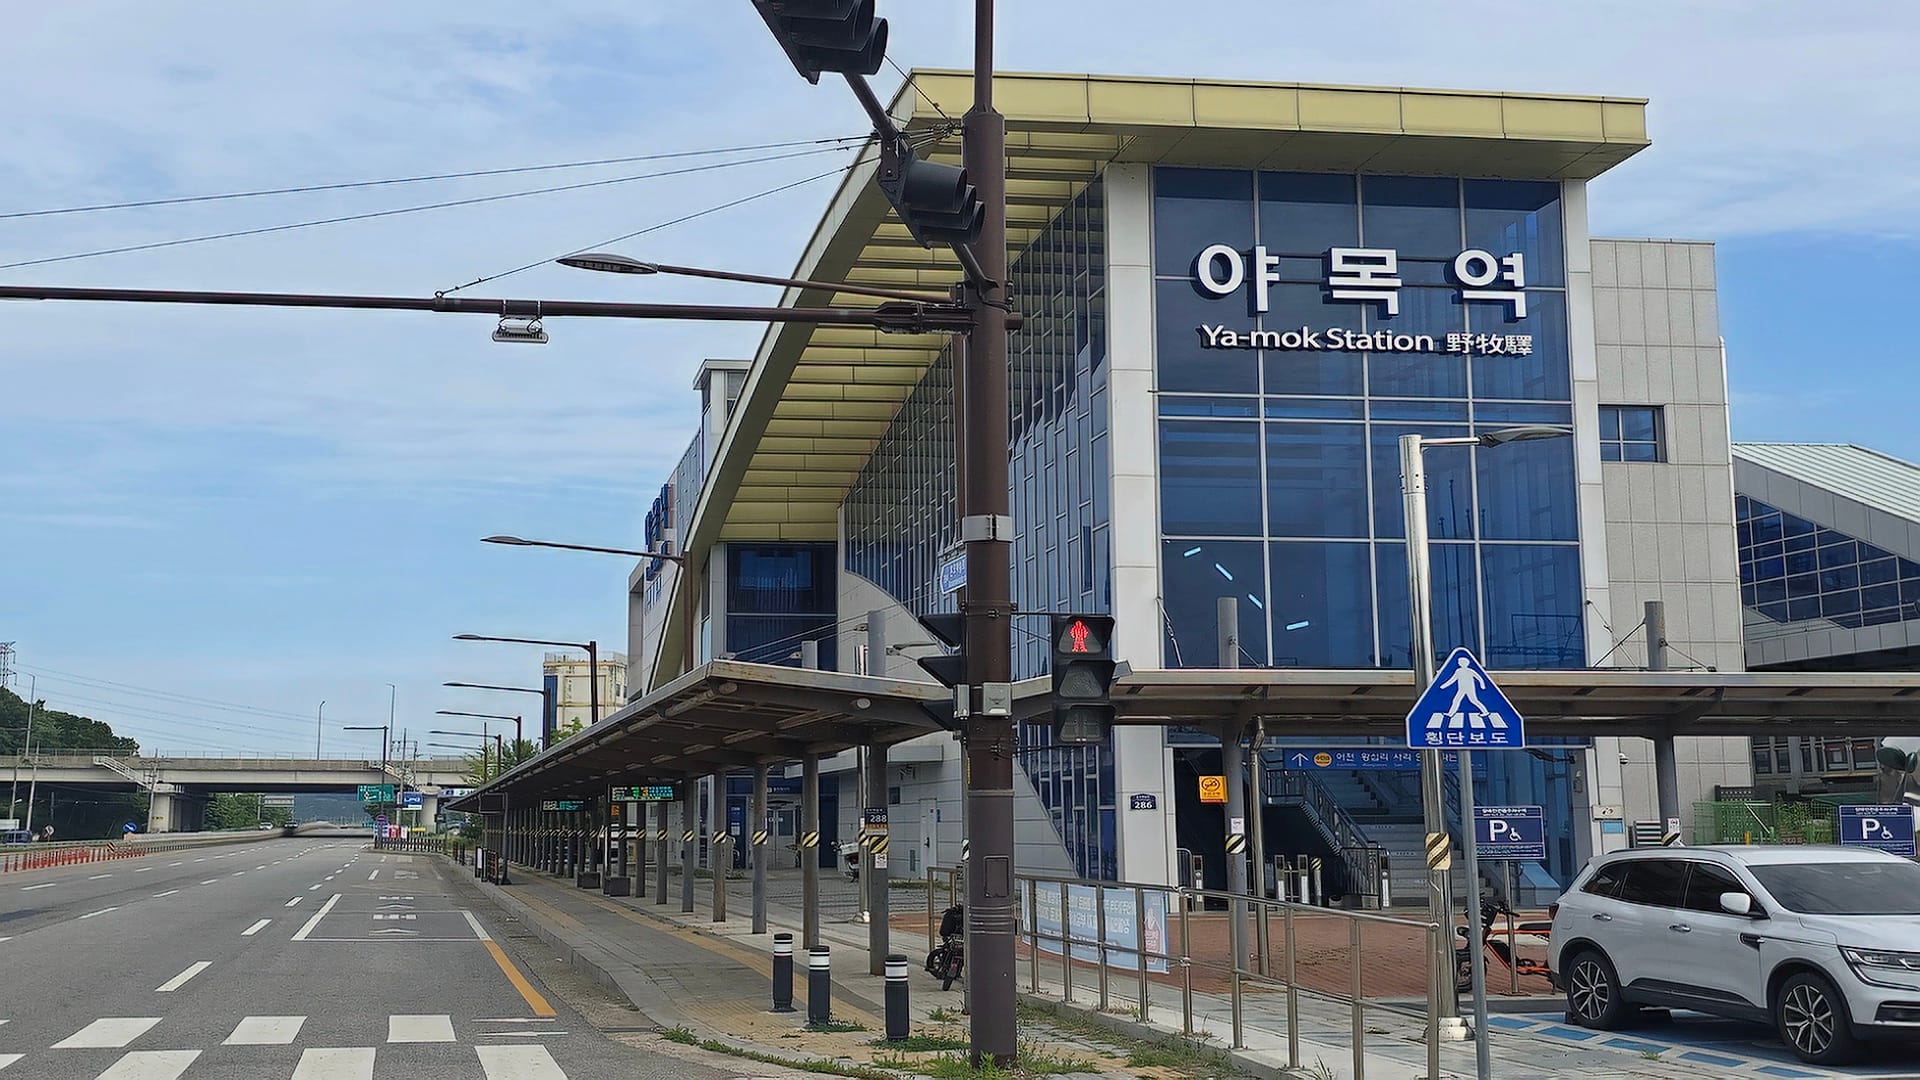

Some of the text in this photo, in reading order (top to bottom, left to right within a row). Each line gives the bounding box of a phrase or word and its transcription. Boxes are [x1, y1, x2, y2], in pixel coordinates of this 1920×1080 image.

[1197, 244, 1528, 318] 야목역
[1202, 324, 1533, 356] Ya-mok Station 野牧驛
[1425, 731, 1509, 745] 횡단보도
[1134, 801, 1153, 810] 286
[870, 814, 888, 823] 288
[1861, 818, 1880, 840] P
[1489, 819, 1508, 842] P
